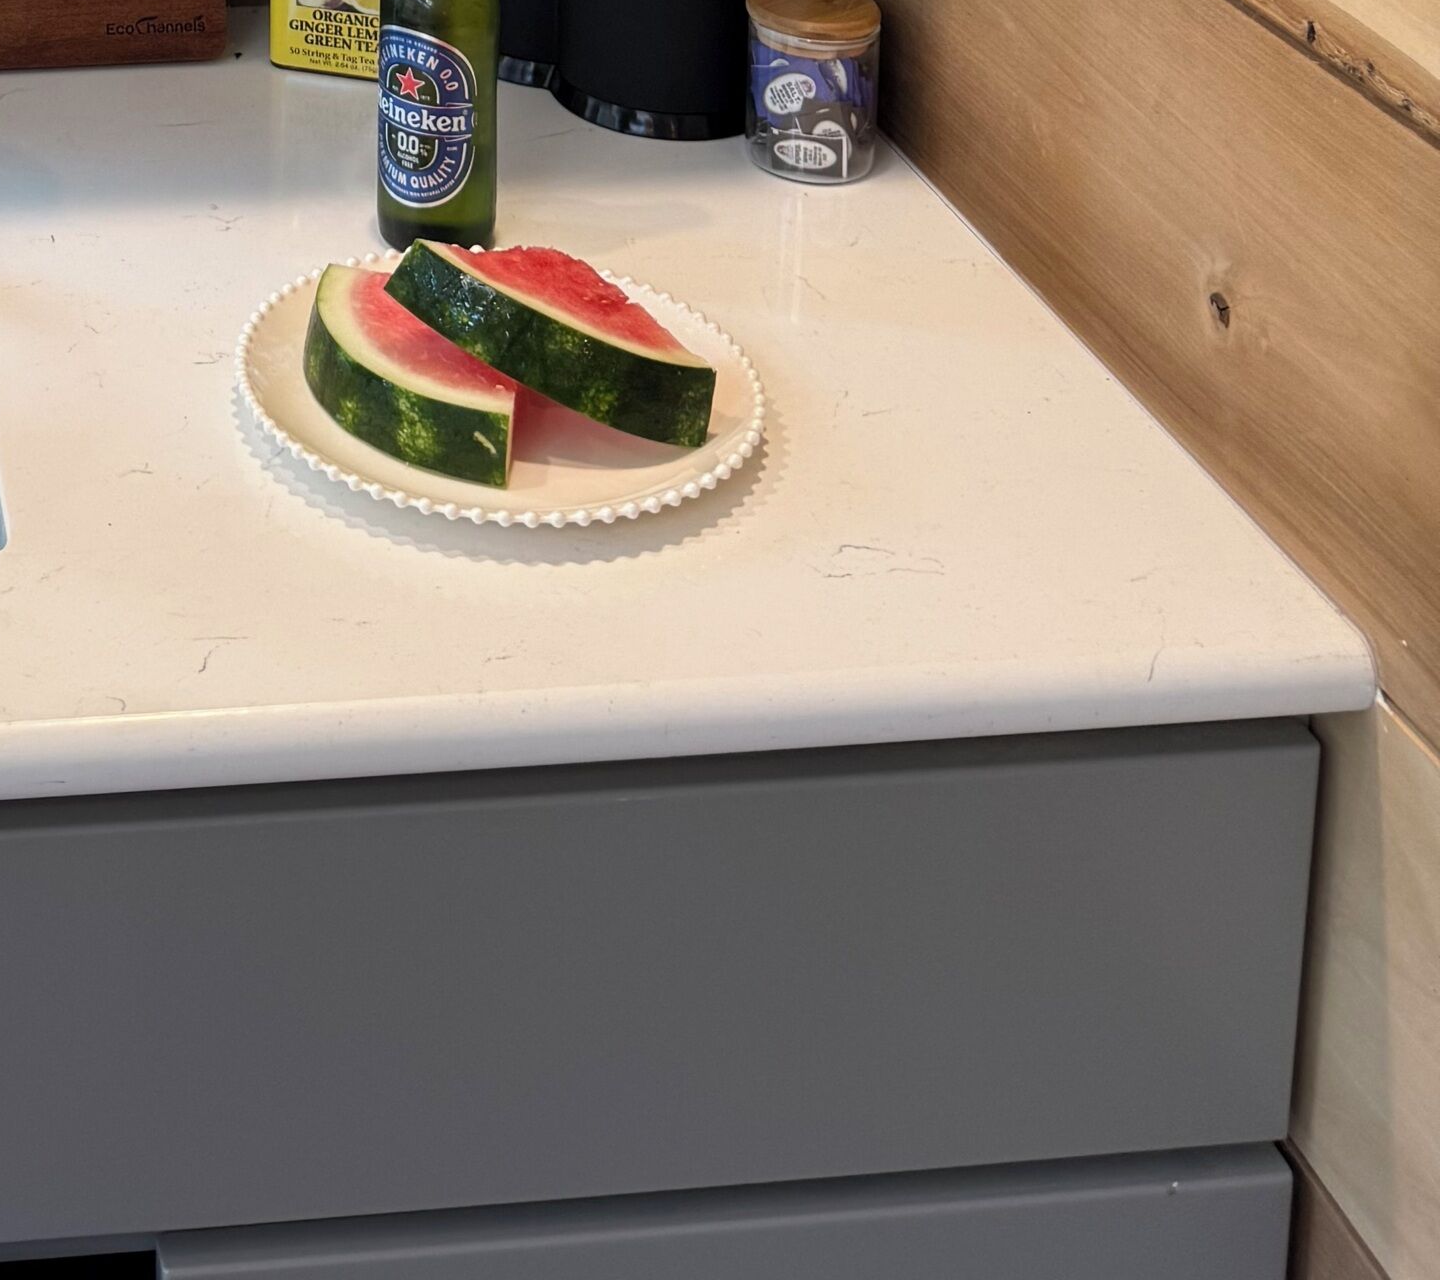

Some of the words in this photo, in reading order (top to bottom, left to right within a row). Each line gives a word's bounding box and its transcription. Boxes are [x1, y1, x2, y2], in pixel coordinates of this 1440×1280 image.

[312, 9, 380, 28] ORGANIC
[289, 19, 344, 36] GINGER
[347, 26, 378, 41] LEM
[304, 33, 352, 50] GREEN
[302, 48, 331, 61] String
[332, 52, 340, 60] &
[342, 53, 358, 65] Tag
[360, 57, 375, 65] Tea
[440, 68, 459, 91] 0.0
[397, 131, 420, 155] 0.0
[410, 155, 456, 189] QUALITY
